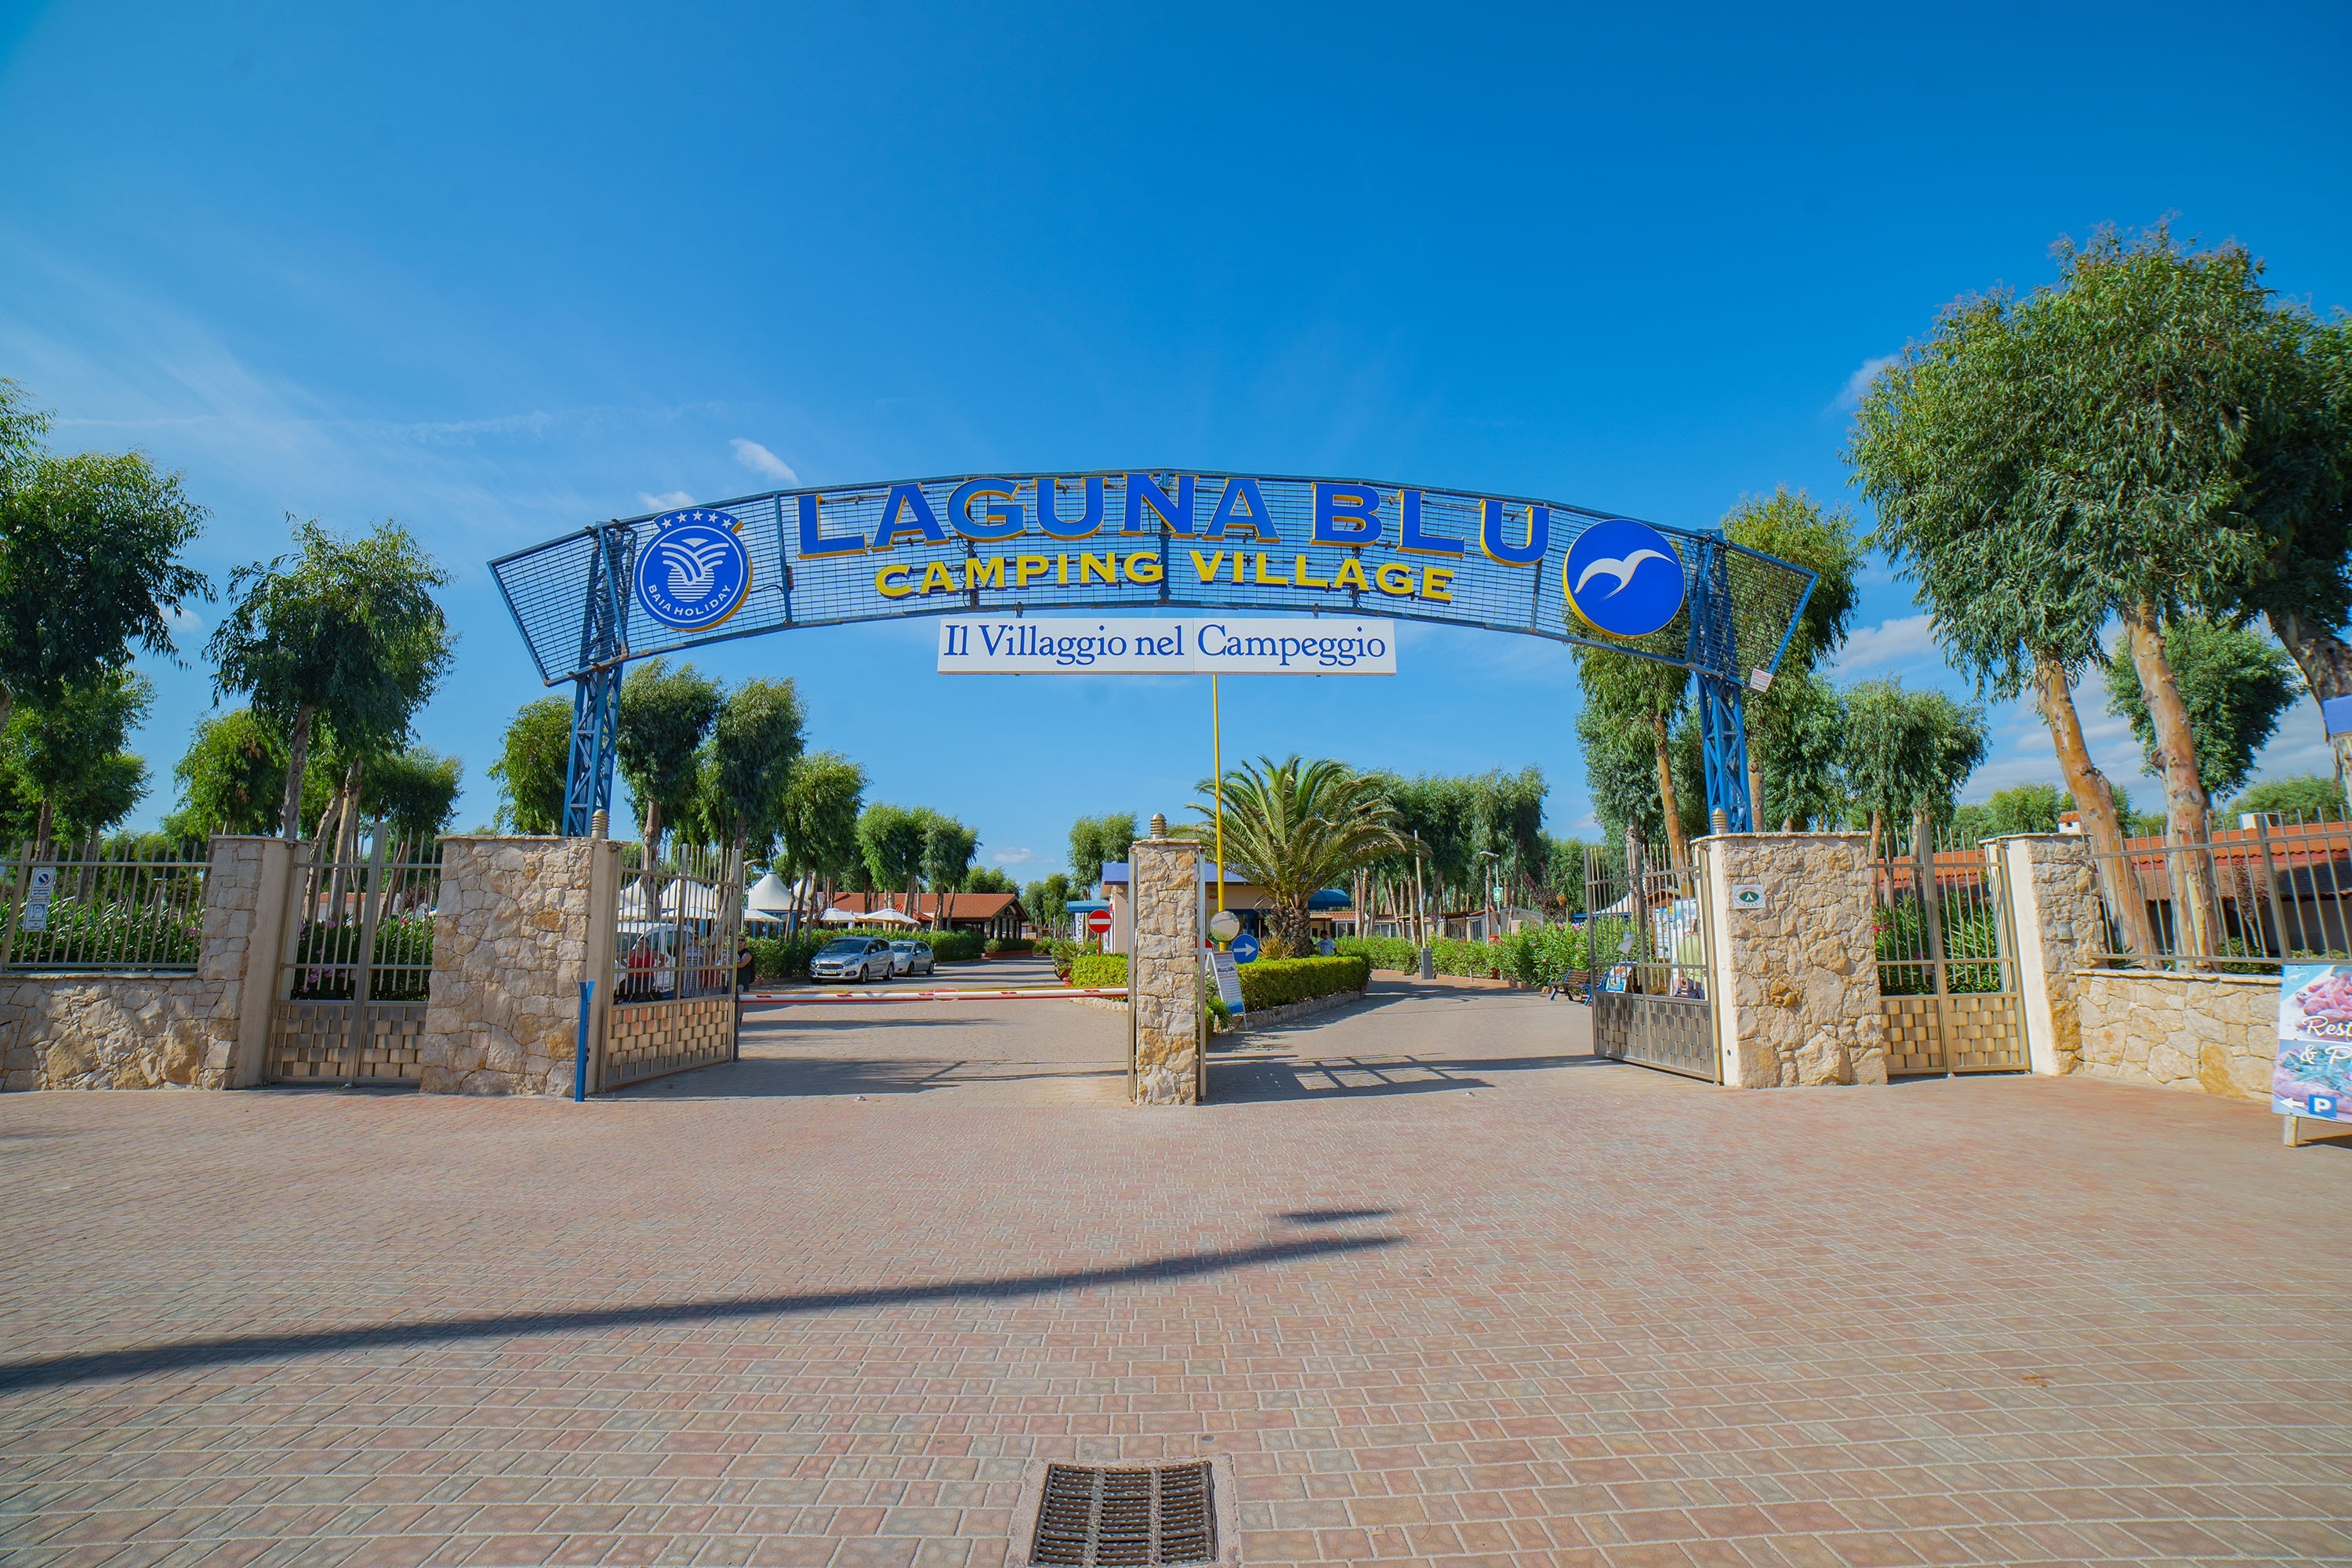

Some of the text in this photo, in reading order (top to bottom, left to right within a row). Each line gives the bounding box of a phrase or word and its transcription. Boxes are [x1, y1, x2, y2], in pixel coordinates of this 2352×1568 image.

[794, 473, 1553, 568] LAGUNA BLU
[875, 550, 1454, 605] CAMPING VILLAGE
[648, 584, 731, 616] BAIA HOLIDAY
[943, 624, 1386, 666] Il Villaggio nel Campeggio
[2300, 1044, 2318, 1065] &
[2314, 1097, 2332, 1112] P
